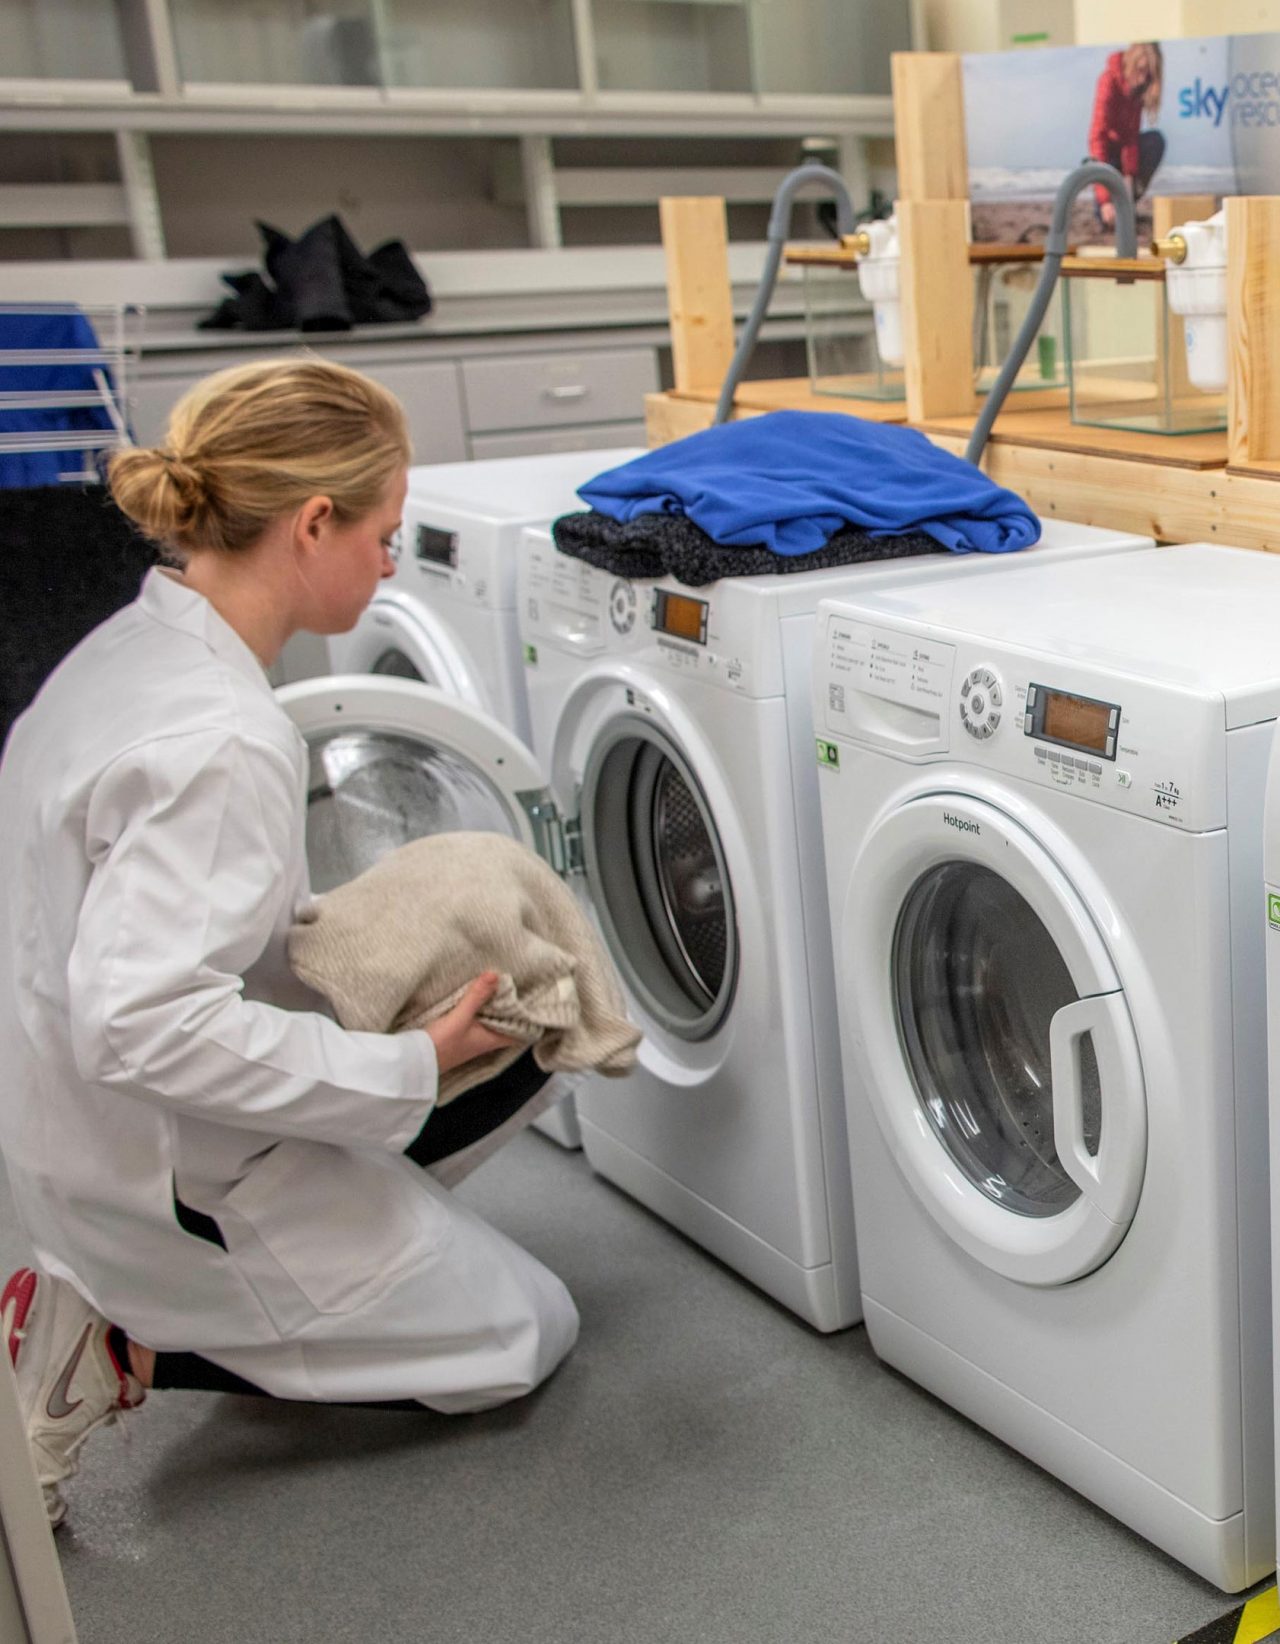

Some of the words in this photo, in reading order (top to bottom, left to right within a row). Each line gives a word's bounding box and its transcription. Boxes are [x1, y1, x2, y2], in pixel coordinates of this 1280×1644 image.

[1179, 76, 1229, 127] sky
[1169, 782, 1174, 792] 7
[944, 812, 980, 835] Hotpoint
